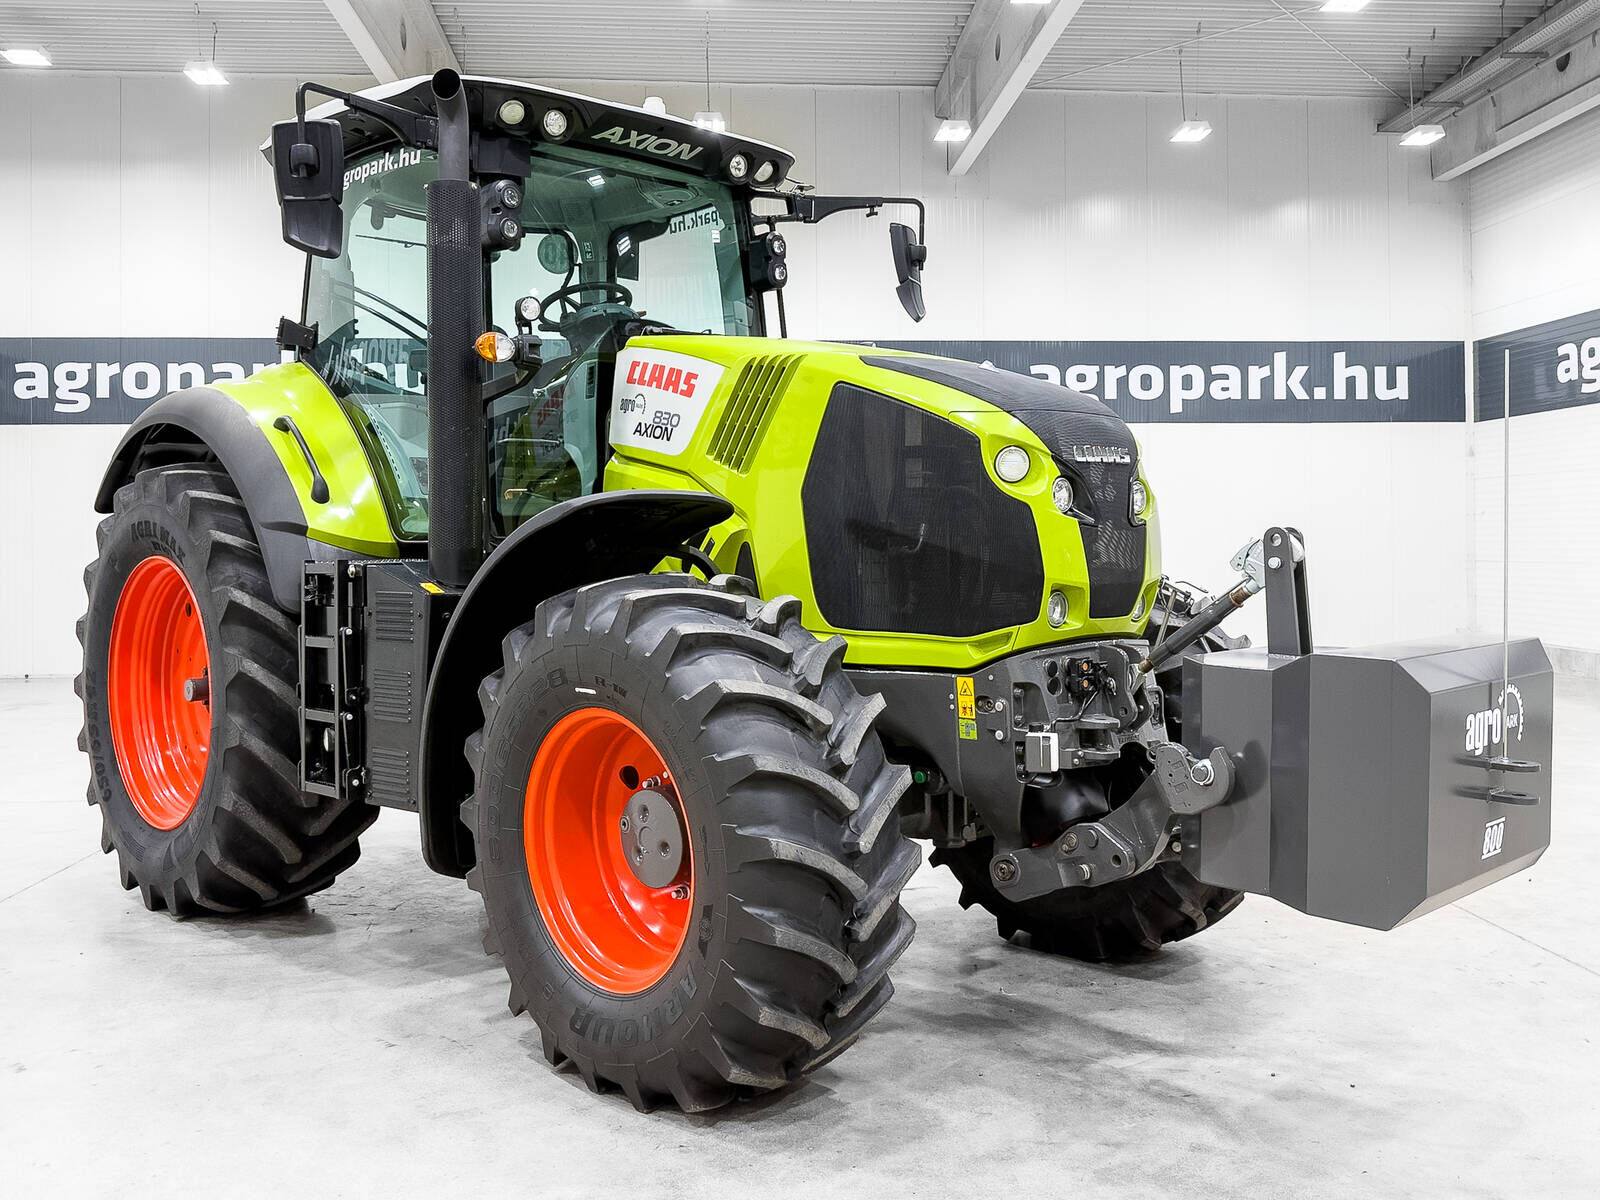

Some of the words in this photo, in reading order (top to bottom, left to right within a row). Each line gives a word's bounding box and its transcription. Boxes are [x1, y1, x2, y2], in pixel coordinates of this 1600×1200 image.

[591, 126, 704, 160] AXION
[626, 360, 699, 398] CLAAS
[1029, 351, 1409, 414] agropark.hu
[633, 421, 673, 442] AXION
[653, 410, 681, 428] 830
[1465, 707, 1501, 756] agro
[1482, 821, 1505, 857] 800
